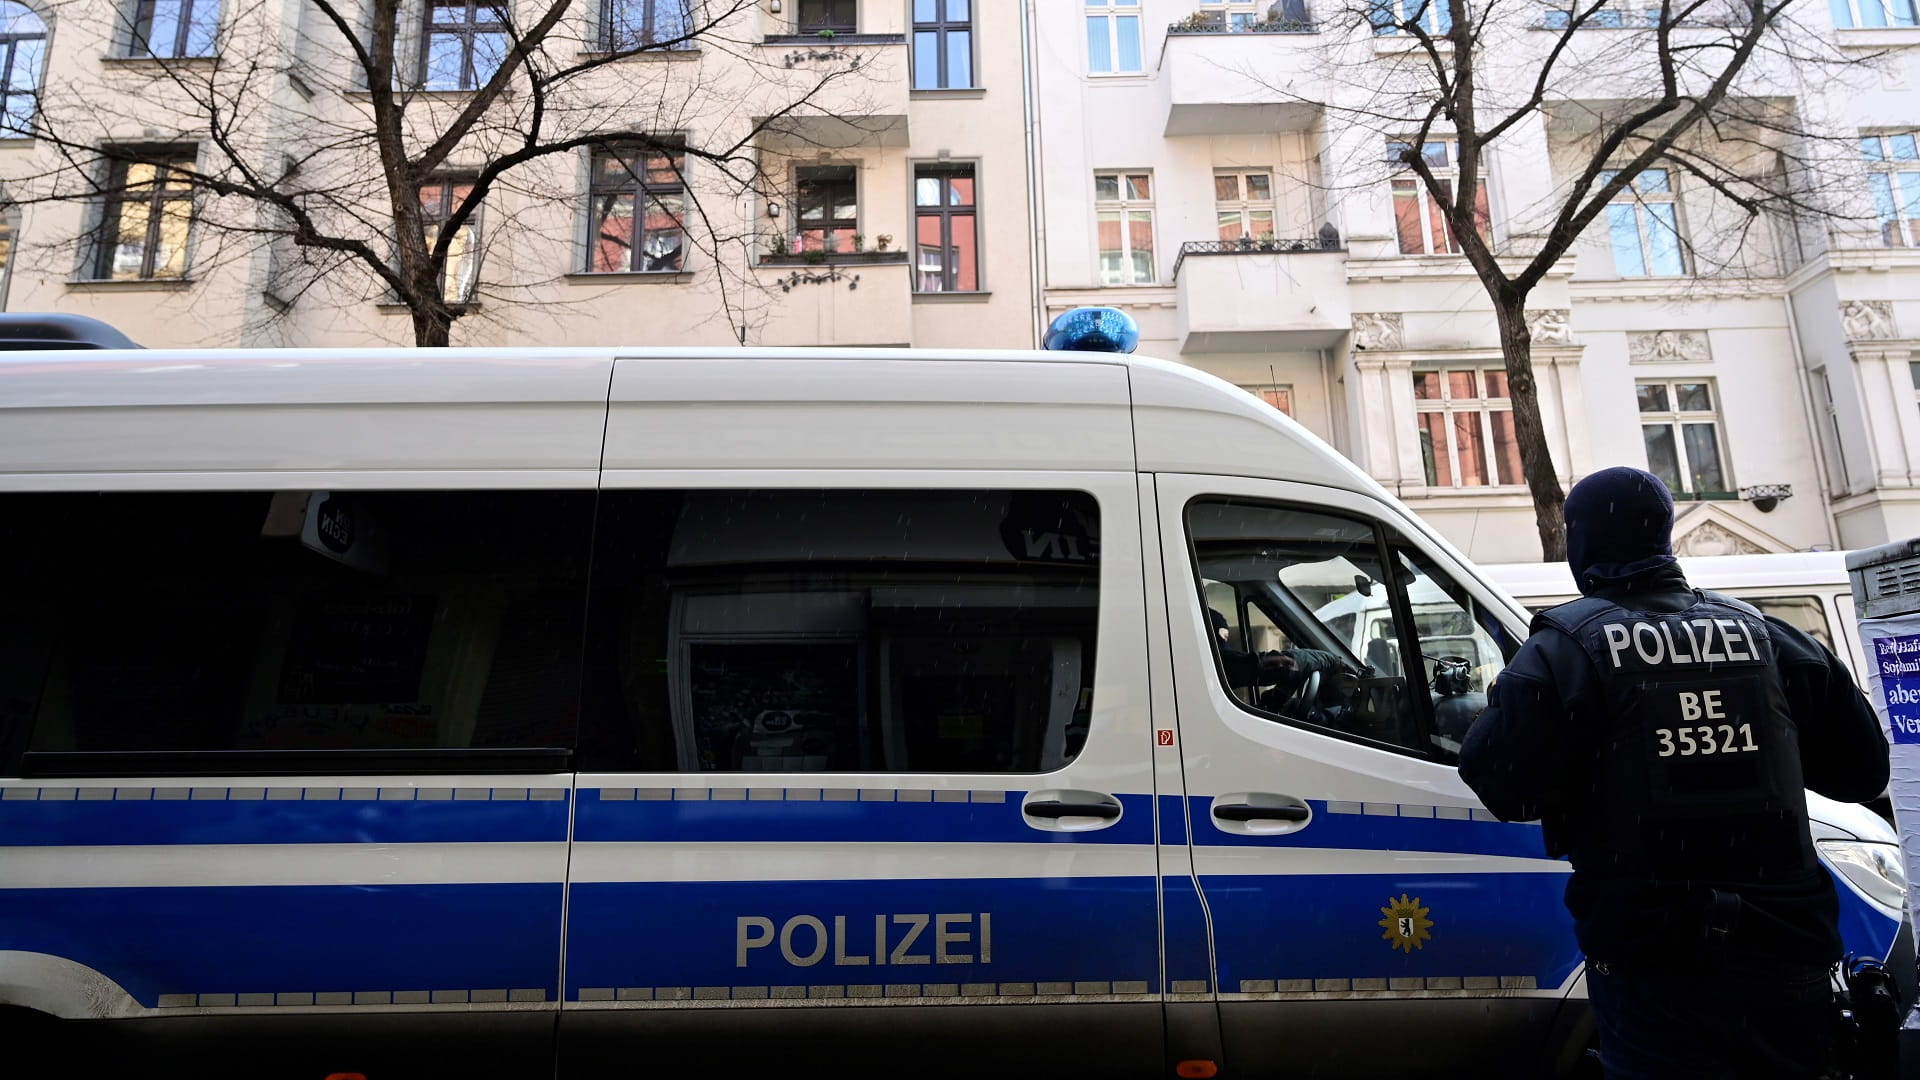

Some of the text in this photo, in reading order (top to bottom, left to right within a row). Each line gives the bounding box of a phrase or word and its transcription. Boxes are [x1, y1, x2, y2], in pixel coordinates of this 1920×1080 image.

[1603, 618, 1761, 668] POLIZEI
[1883, 658, 1920, 676] Sojami
[1679, 690, 1726, 721] BE
[1656, 723, 1759, 757] 35321
[736, 913, 991, 967] POLIZEI
